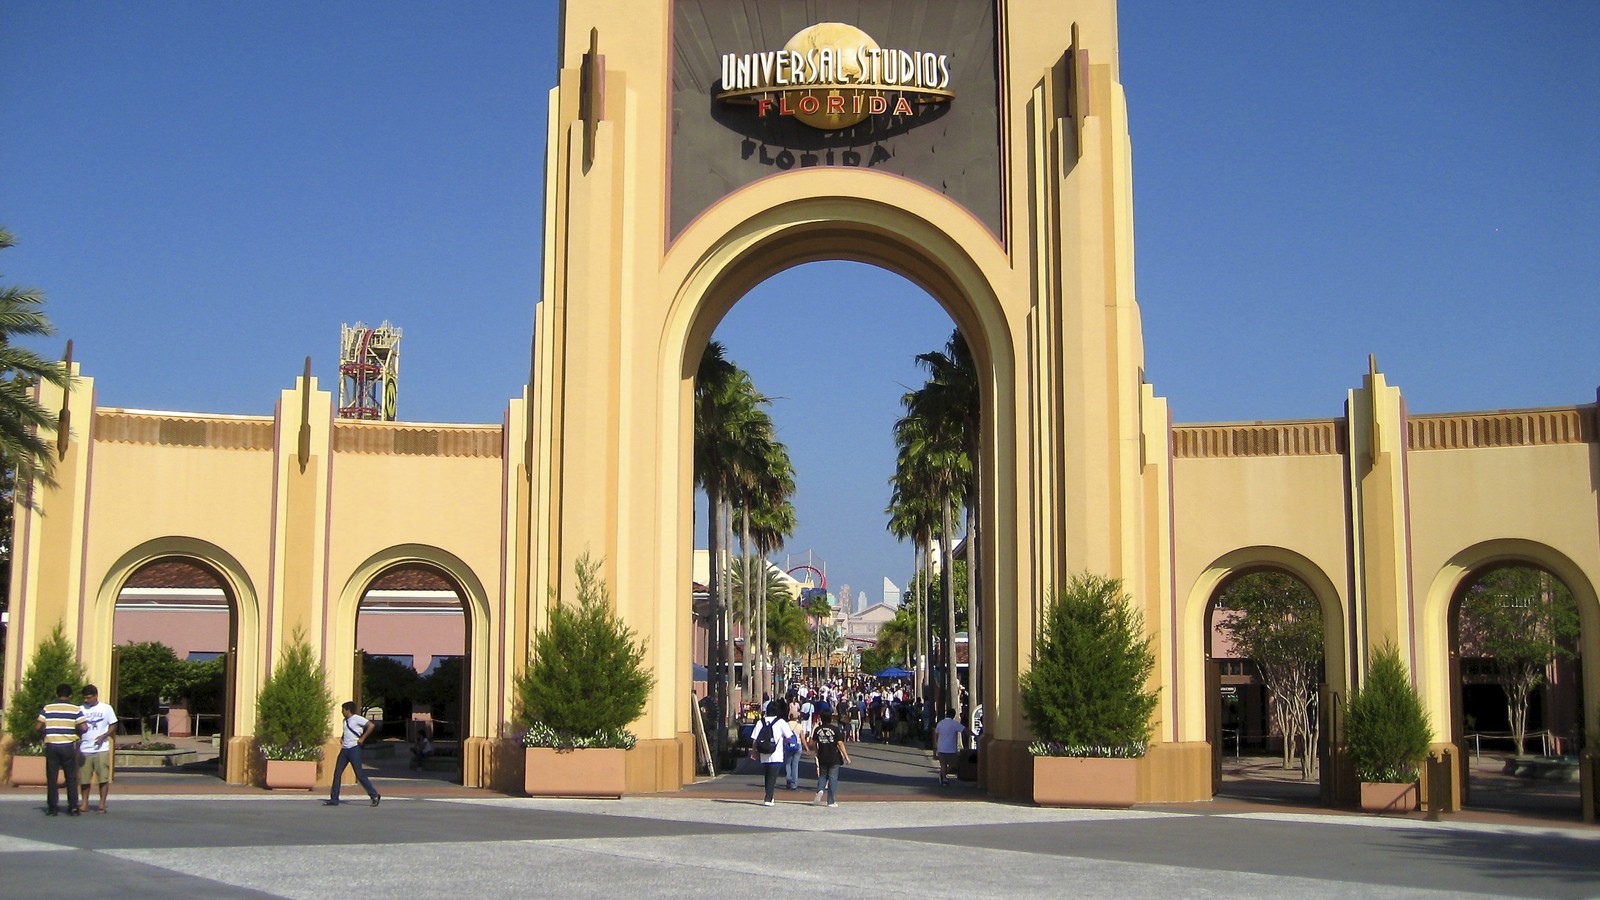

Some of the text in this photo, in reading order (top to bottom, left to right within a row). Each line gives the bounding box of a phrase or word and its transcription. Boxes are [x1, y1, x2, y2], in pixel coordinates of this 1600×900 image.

[721, 44, 950, 90] UNIVERSAL STUDIOS
[758, 95, 914, 118] FLORIDA
